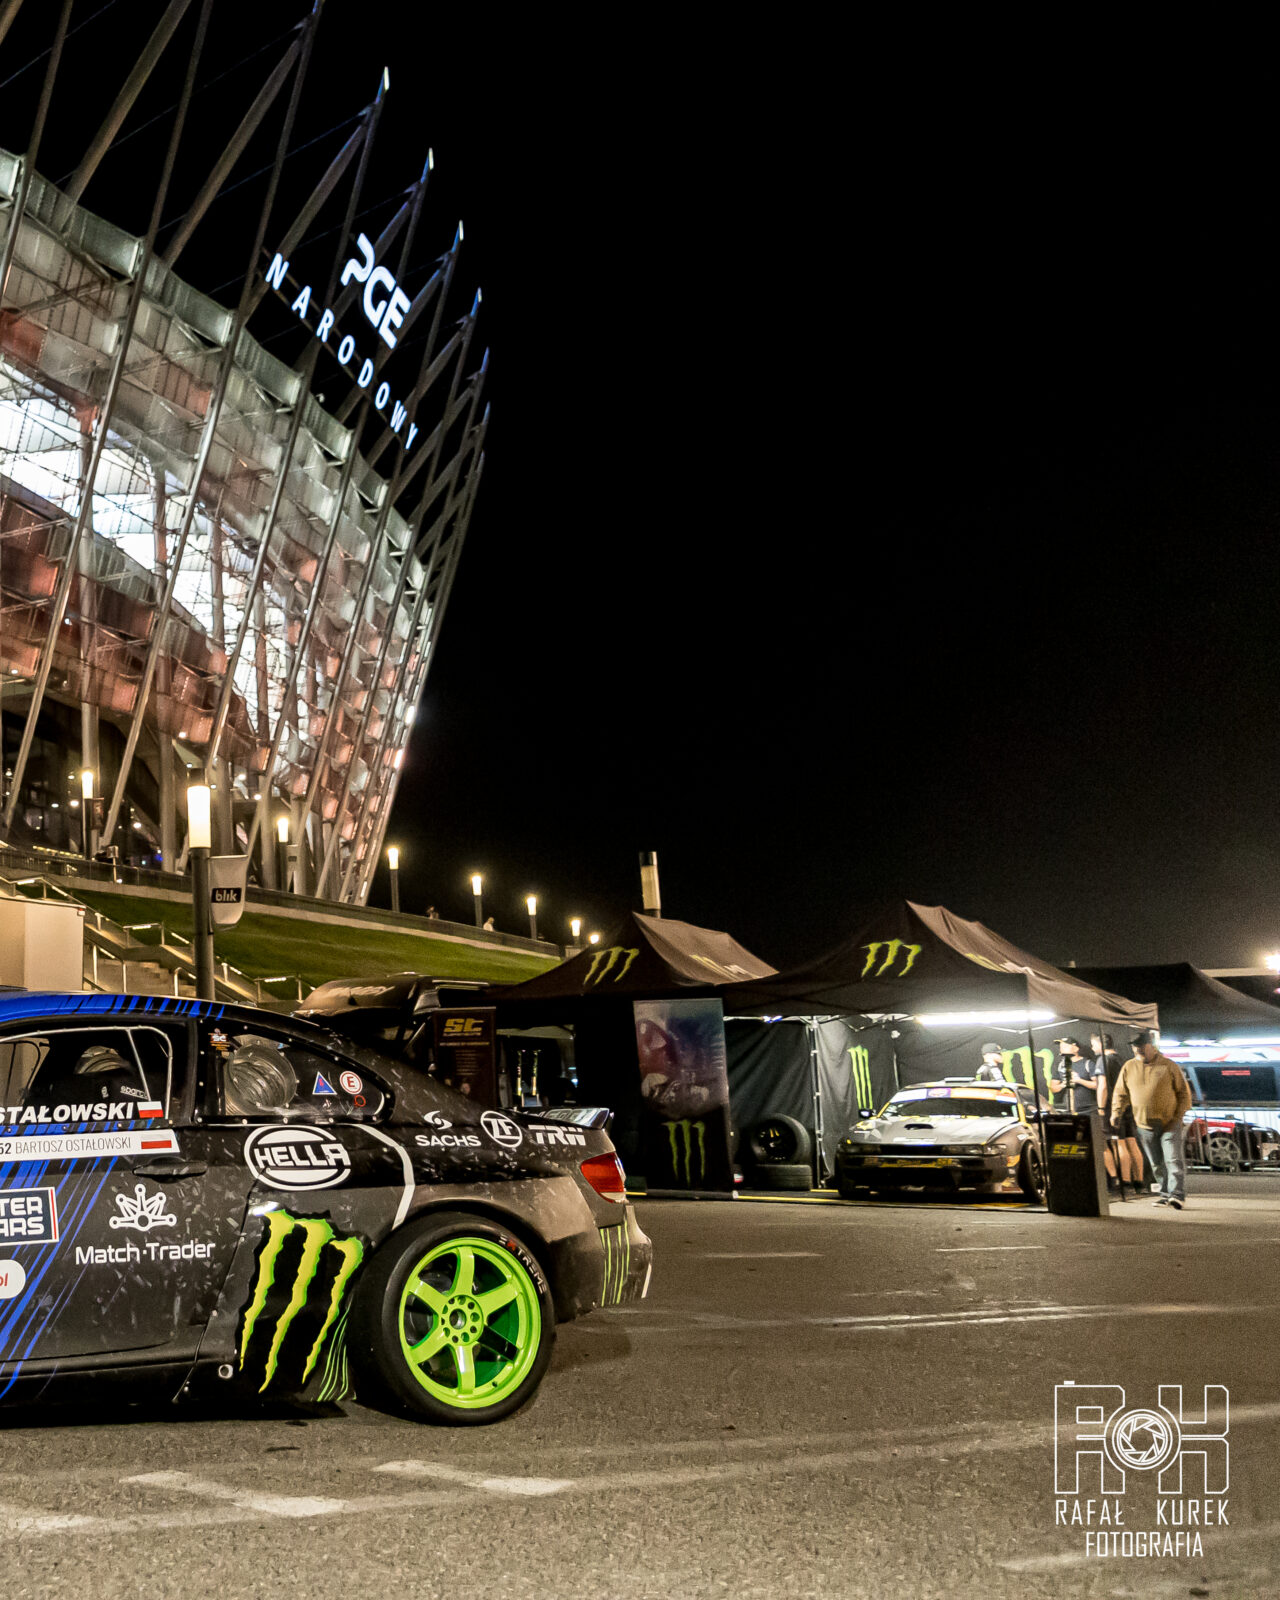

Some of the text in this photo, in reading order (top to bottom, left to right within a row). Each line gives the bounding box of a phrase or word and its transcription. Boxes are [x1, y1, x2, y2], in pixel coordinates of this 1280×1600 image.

[340, 233, 412, 349] PGE
[265, 253, 418, 449] NARODOWY
[215, 889, 238, 902] blik
[120, 1085, 148, 1100] sparc
[15, 1139, 64, 1154] BARTOSZ
[65, 1136, 132, 1152] OSTAŁOWSKI
[415, 1134, 482, 1147] SACHS
[528, 1124, 587, 1146] TRW
[253, 1142, 352, 1169] HELLA
